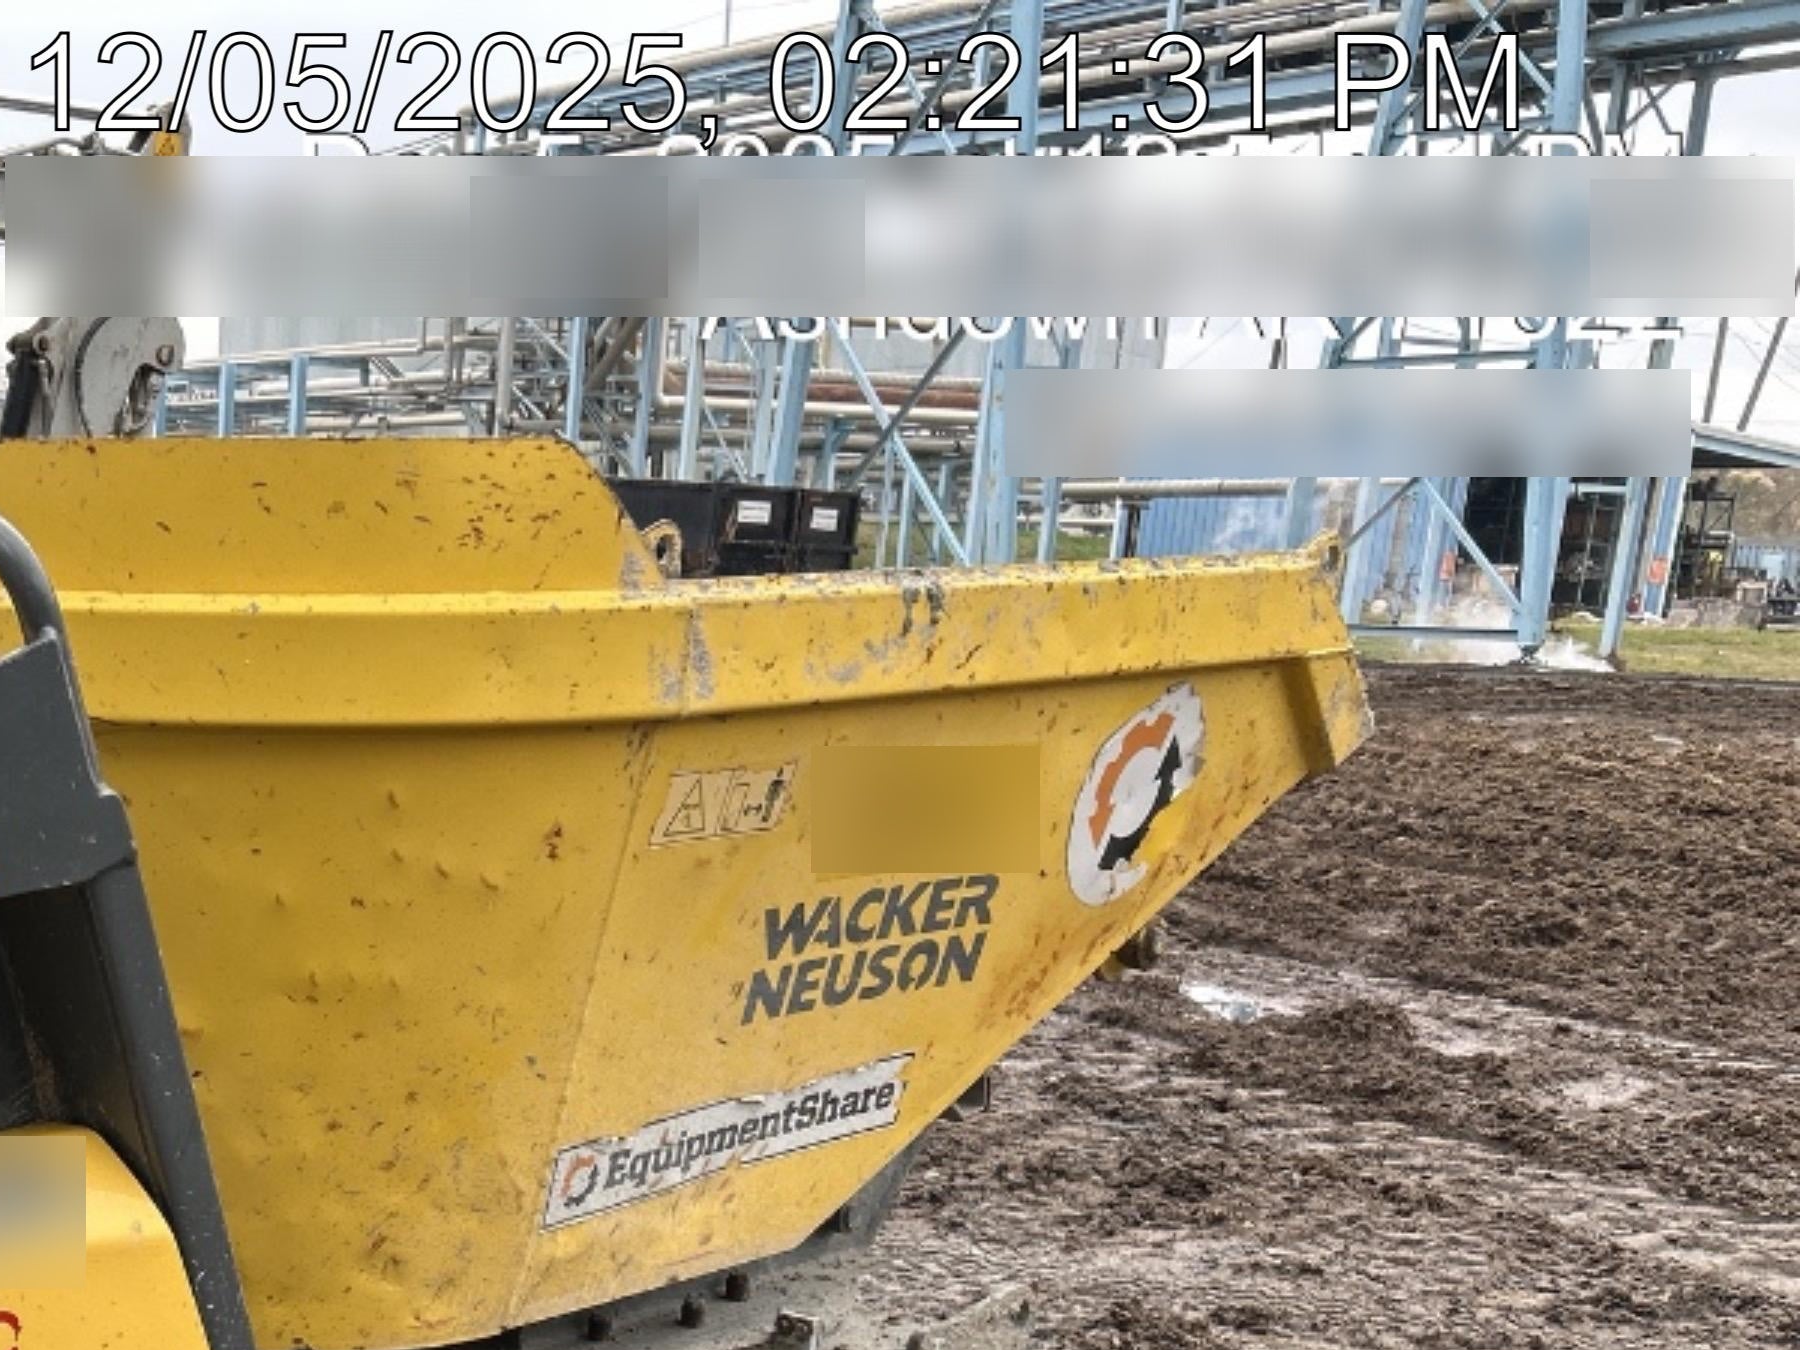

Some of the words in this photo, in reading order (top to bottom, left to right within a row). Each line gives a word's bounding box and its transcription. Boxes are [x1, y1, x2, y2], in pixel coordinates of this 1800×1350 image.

[764, 873, 1000, 961] WACKER
[741, 931, 988, 1026] NEUSON
[603, 1080, 896, 1190] EquipmentShare
